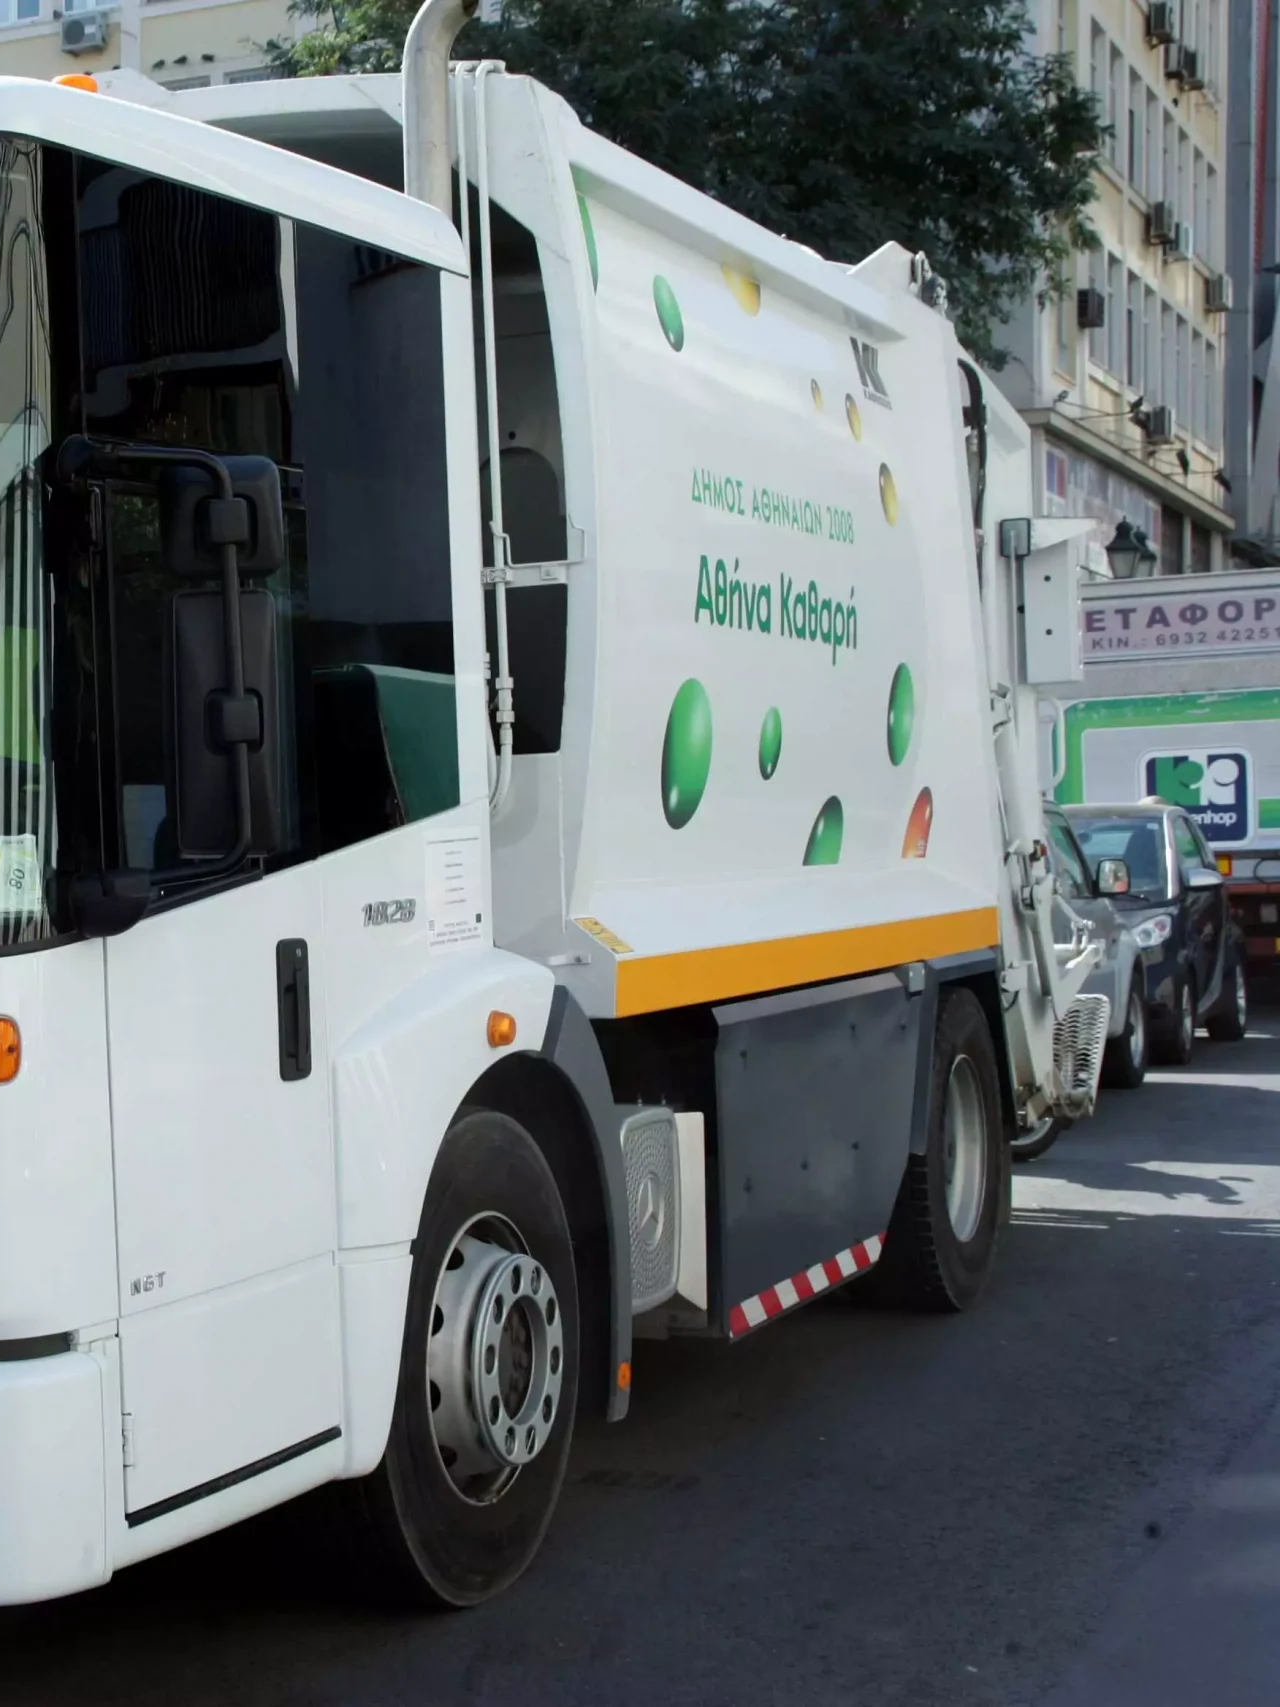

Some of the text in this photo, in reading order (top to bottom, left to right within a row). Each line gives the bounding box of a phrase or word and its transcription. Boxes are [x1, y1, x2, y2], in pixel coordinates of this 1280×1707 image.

[692, 468, 855, 544] ΔΗΜΟΣ ΑΘΗΝΑΙΩΝ 2008
[695, 554, 858, 667] Αθήνα Καθαρή
[1155, 631, 1208, 647] 6932
[361, 898, 417, 927] 1828
